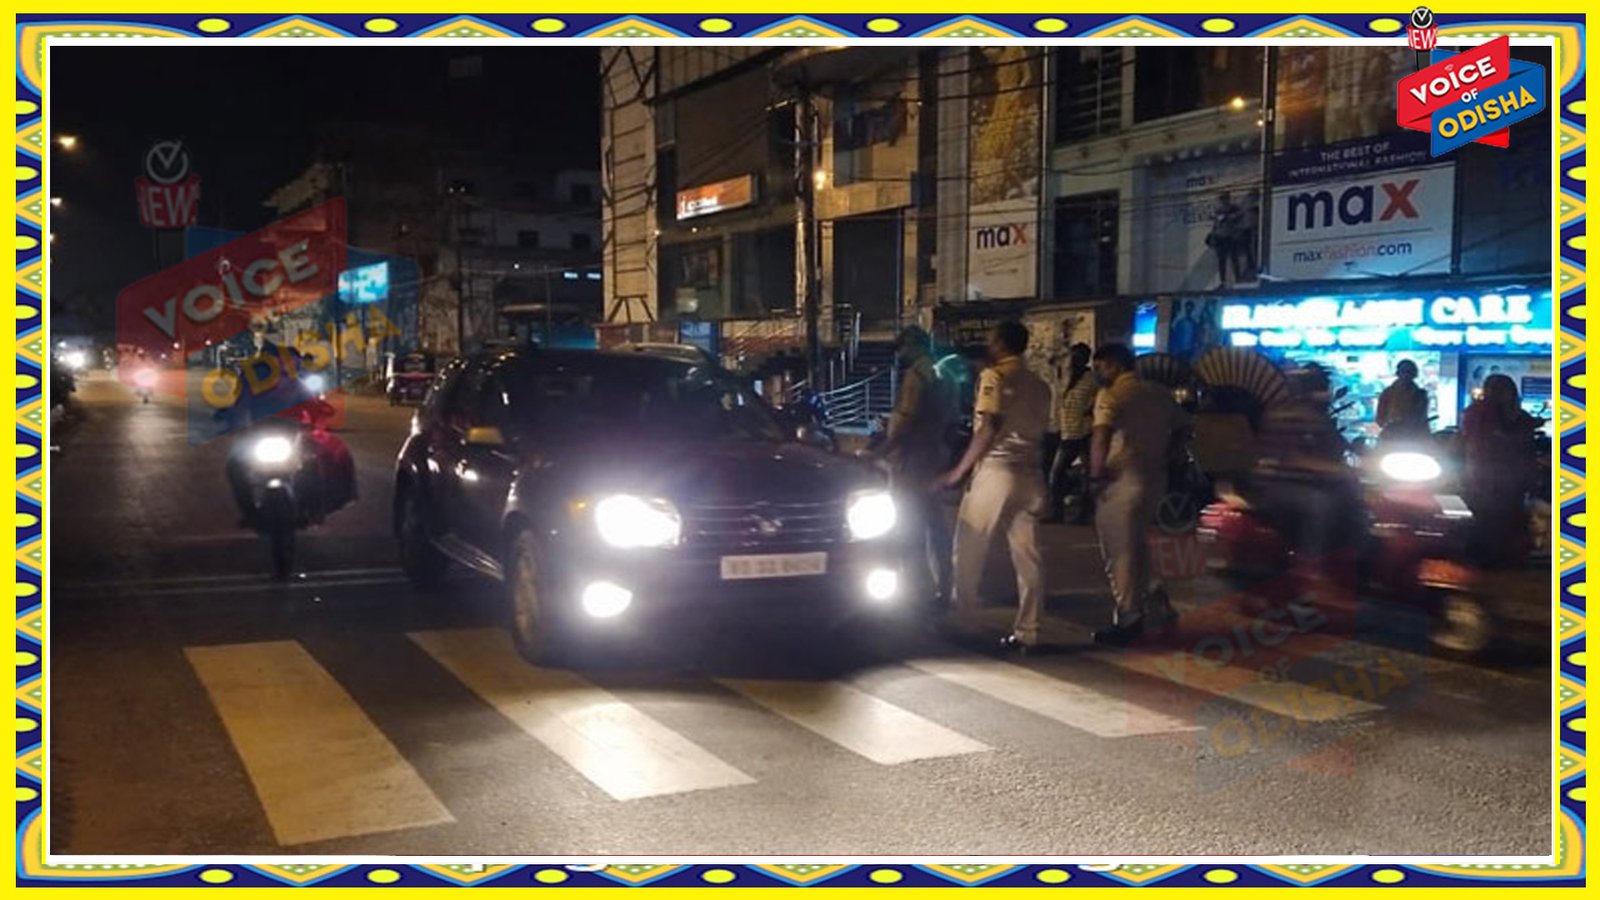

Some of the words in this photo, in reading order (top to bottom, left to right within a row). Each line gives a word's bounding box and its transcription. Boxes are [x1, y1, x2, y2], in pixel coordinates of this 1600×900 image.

[1321, 151, 1341, 161] THE
[1343, 145, 1371, 159] BEST
[1287, 179, 1420, 231] max
[976, 222, 1027, 249] max
